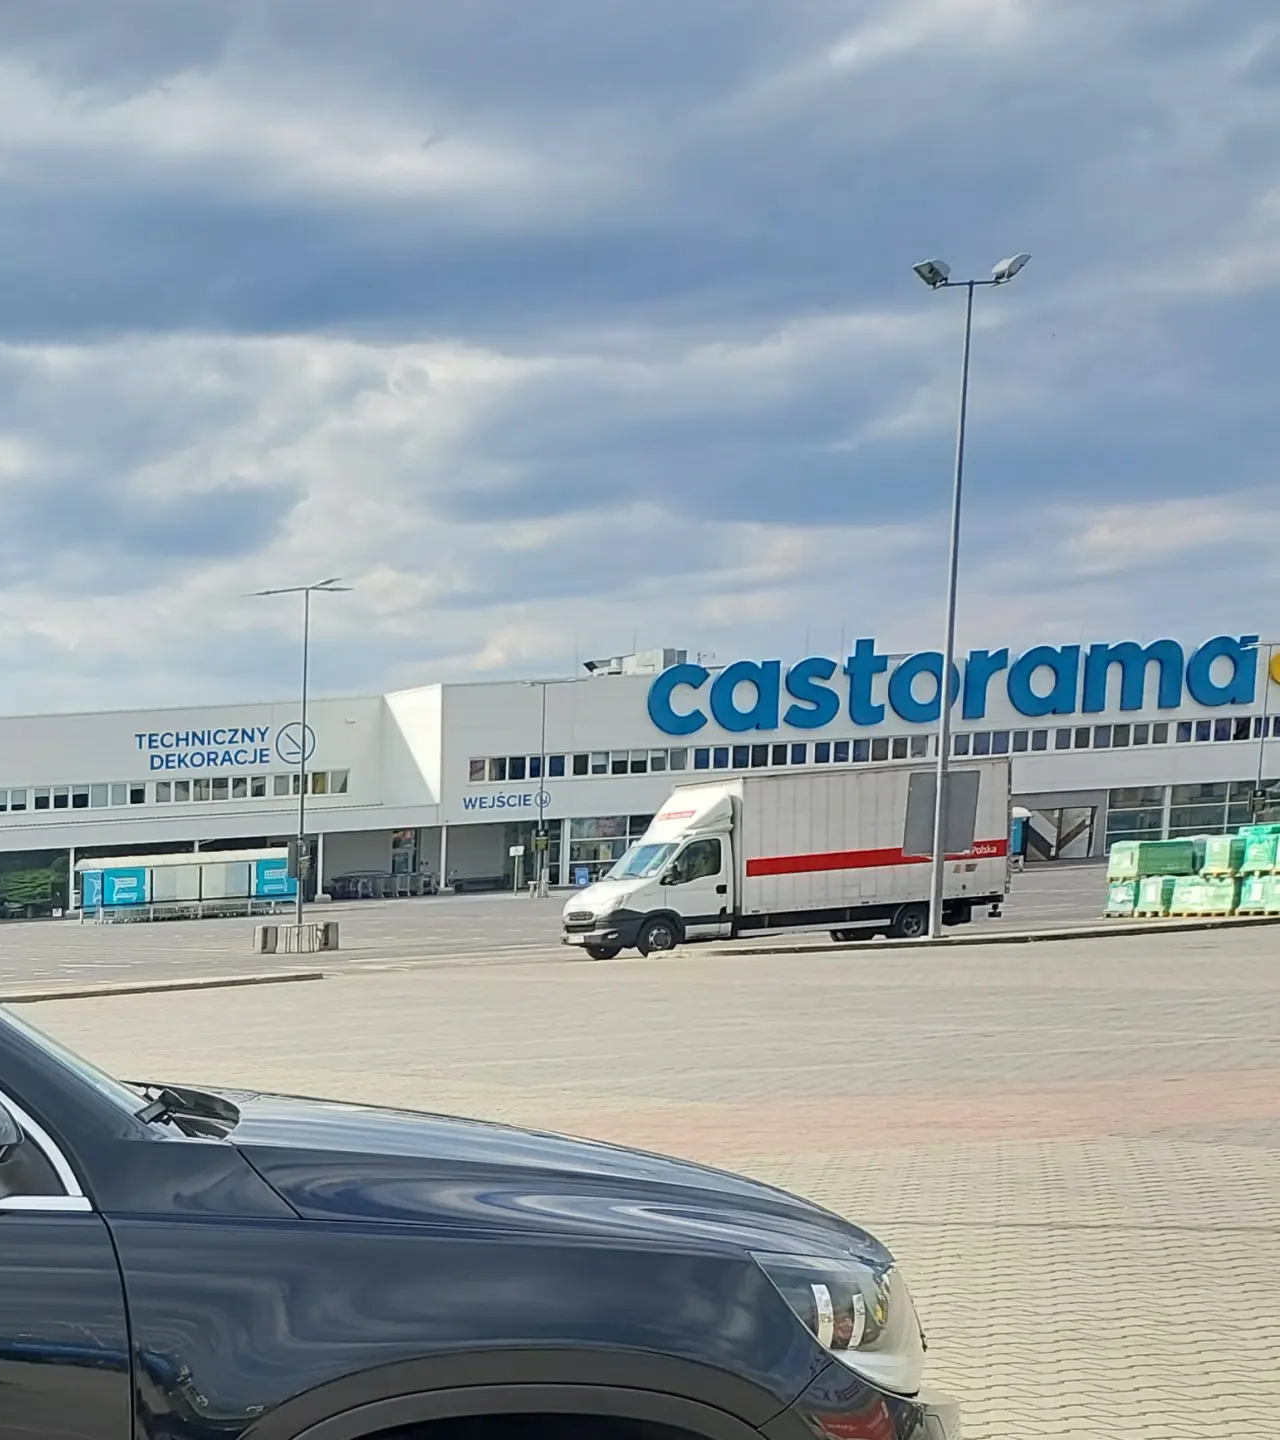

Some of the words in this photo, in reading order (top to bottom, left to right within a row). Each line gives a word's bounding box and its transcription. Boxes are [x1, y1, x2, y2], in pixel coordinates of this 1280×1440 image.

[647, 634, 1259, 736] castorama
[134, 726, 270, 750] TECHNICZNY
[149, 748, 271, 770] DEKORACJE
[463, 791, 532, 810] WEJŚCIE
[972, 844, 997, 855] Polska
